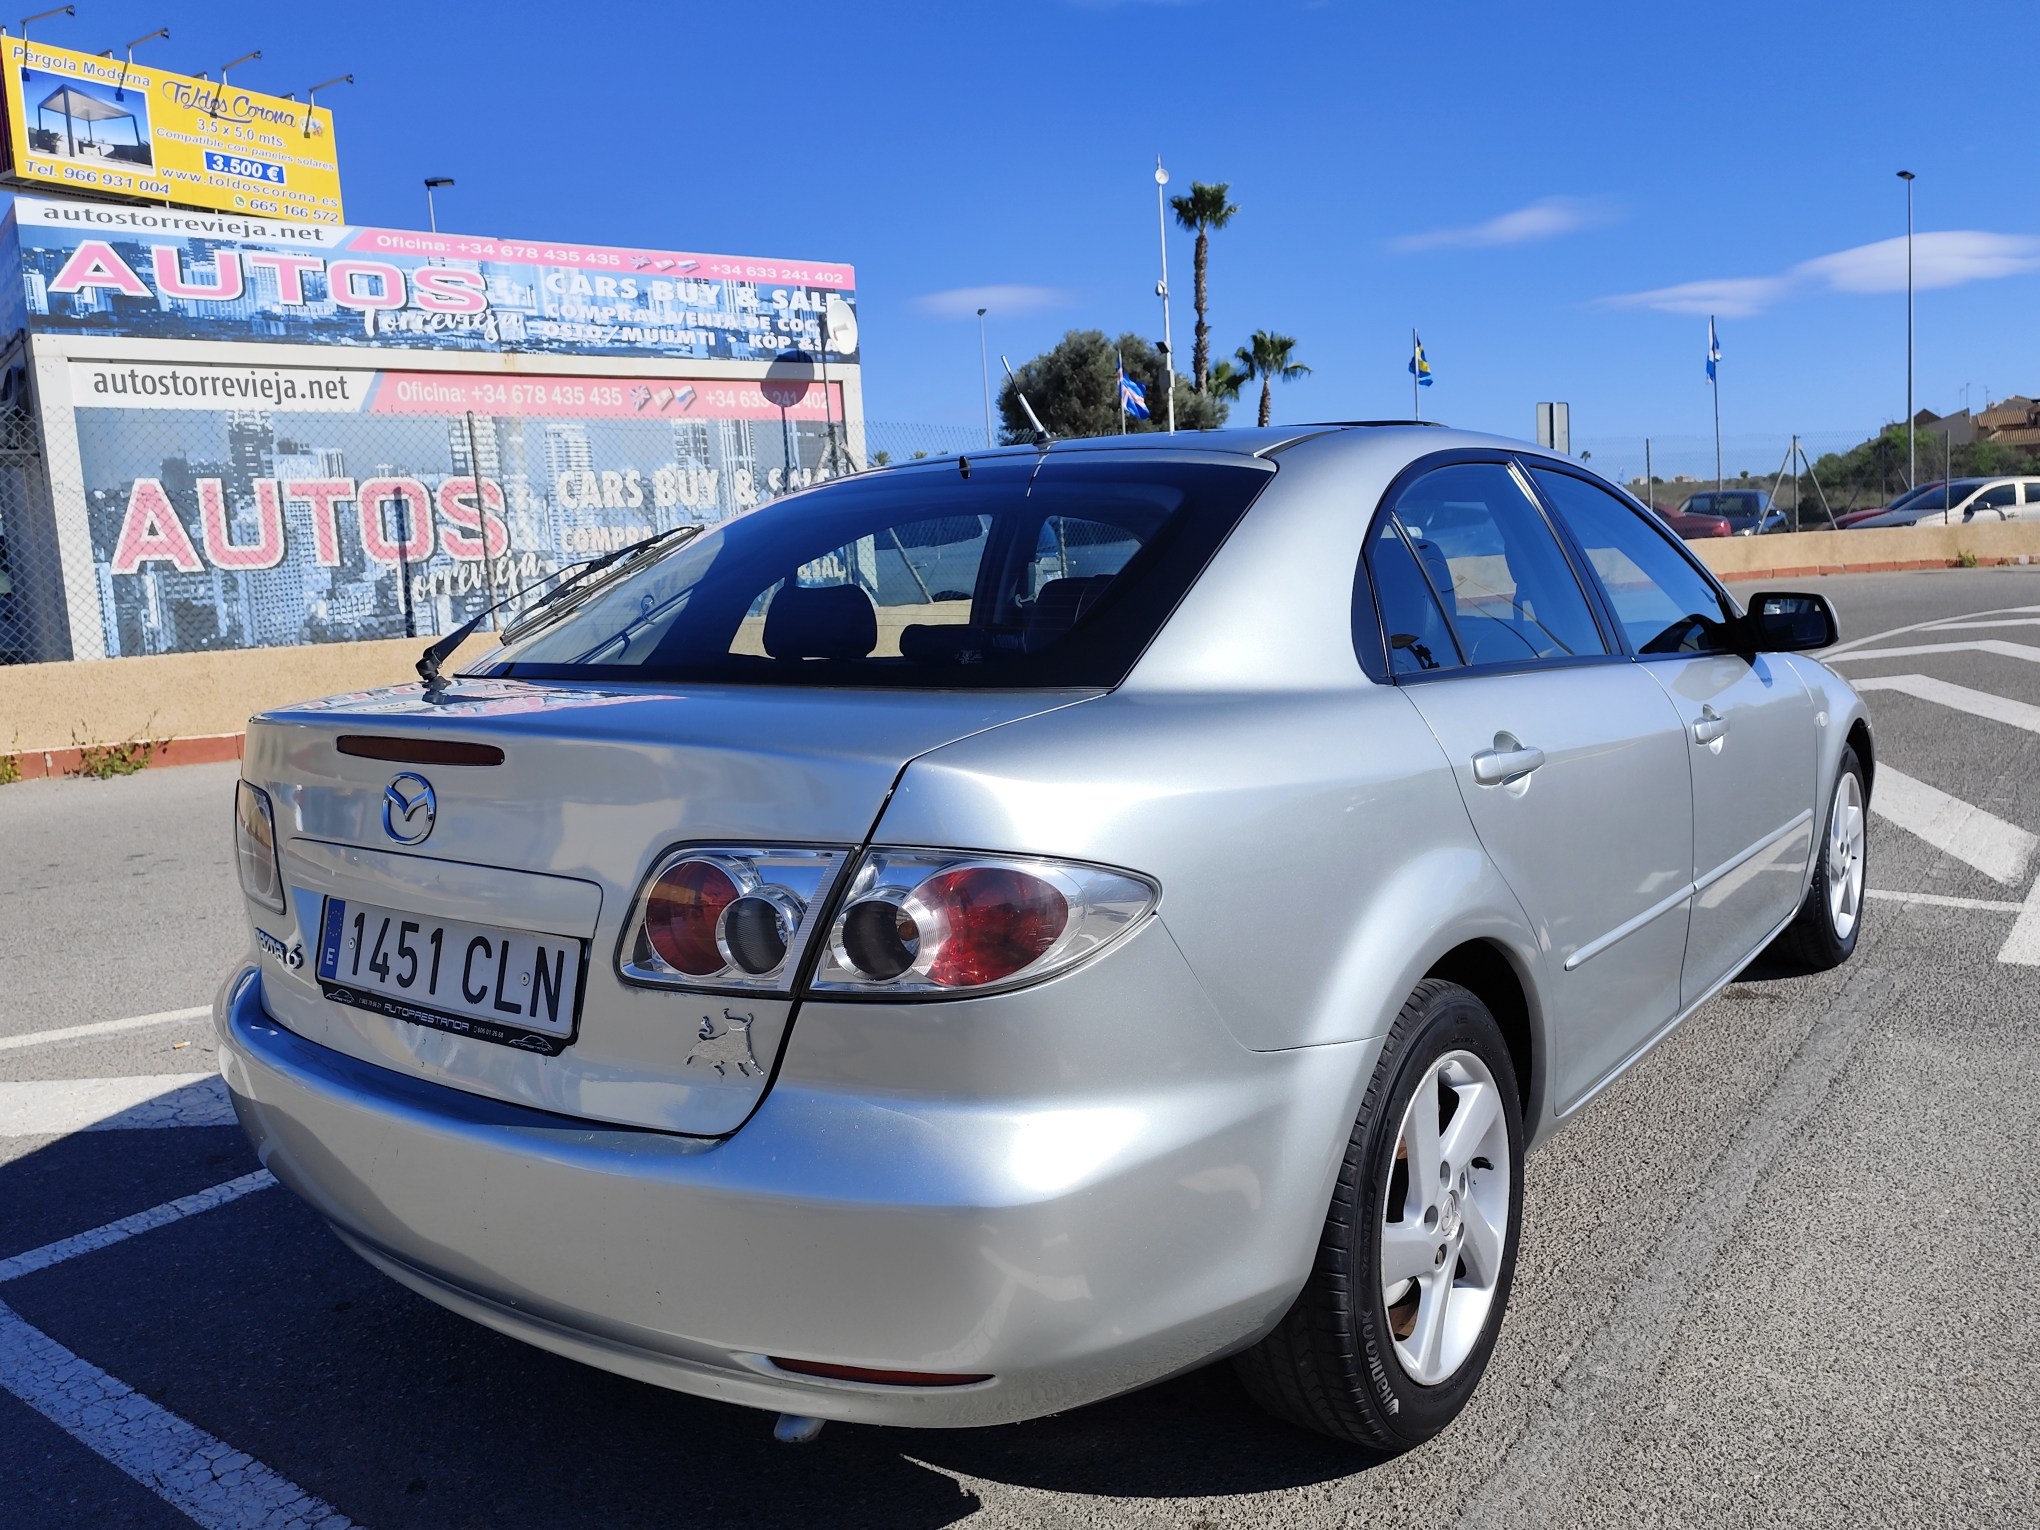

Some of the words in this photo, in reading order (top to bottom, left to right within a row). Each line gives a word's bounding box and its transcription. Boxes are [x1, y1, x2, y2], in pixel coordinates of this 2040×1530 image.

[83, 62, 151, 87] Moderna
[162, 80, 228, 113] Toldos
[233, 95, 296, 128] Corona
[156, 127, 224, 149] Compatible
[227, 143, 249, 154] con
[251, 147, 294, 163] paneles
[297, 157, 335, 171] solares
[198, 118, 219, 133] 3,5
[223, 126, 231, 136] x
[235, 126, 255, 141] 5,0
[259, 133, 288, 148] mts.
[25, 160, 58, 177] Tel.
[64, 167, 97, 182] 966
[102, 173, 132, 188] 931
[139, 180, 170, 194] 004
[212, 155, 263, 178] 3.500
[266, 166, 280, 182] €
[161, 167, 338, 208] www.toldoscorona.es
[43, 206, 324, 241] autostorrevieja.net
[250, 199, 278, 213] 665
[283, 204, 309, 218] 166
[313, 210, 339, 223] 572
[376, 234, 451, 252] Oficina:
[457, 242, 495, 256] +34
[501, 244, 539, 259] 678
[543, 249, 580, 263] 435
[585, 252, 621, 266] 435
[47, 239, 489, 316] AUTOS
[546, 272, 639, 299] CARS
[651, 279, 722, 305] BUY
[736, 284, 760, 309] &
[710, 263, 741, 276] +34
[746, 266, 777, 279] 633
[781, 268, 811, 282] 241
[815, 271, 844, 284] 402
[360, 309, 525, 344] Torrevieja
[546, 302, 650, 322] COMPRA
[668, 309, 739, 329] VENTA
[745, 315, 771, 331] DE
[748, 331, 791, 349] KÖP
[93, 369, 349, 404] autostorrevieja.net
[397, 381, 466, 403] Oficina:
[471, 383, 507, 404] +34
[511, 384, 547, 404] 678
[551, 385, 585, 405] 435
[589, 386, 623, 406] 435
[706, 389, 736, 408] +34
[740, 391, 768, 408] 633
[556, 470, 643, 508] CARS
[653, 468, 719, 508] BUY
[734, 468, 759, 506] &
[111, 476, 509, 575] AUTOS
[560, 524, 655, 554] COMPRA
[386, 549, 542, 612] Torreveja
[326, 947, 335, 966] E
[352, 912, 443, 995] 1451
[462, 935, 565, 1023] CLN
[383, 1003, 470, 1032] AUTOPRESTANDA
[1361, 1309, 1395, 1406] Hankook
